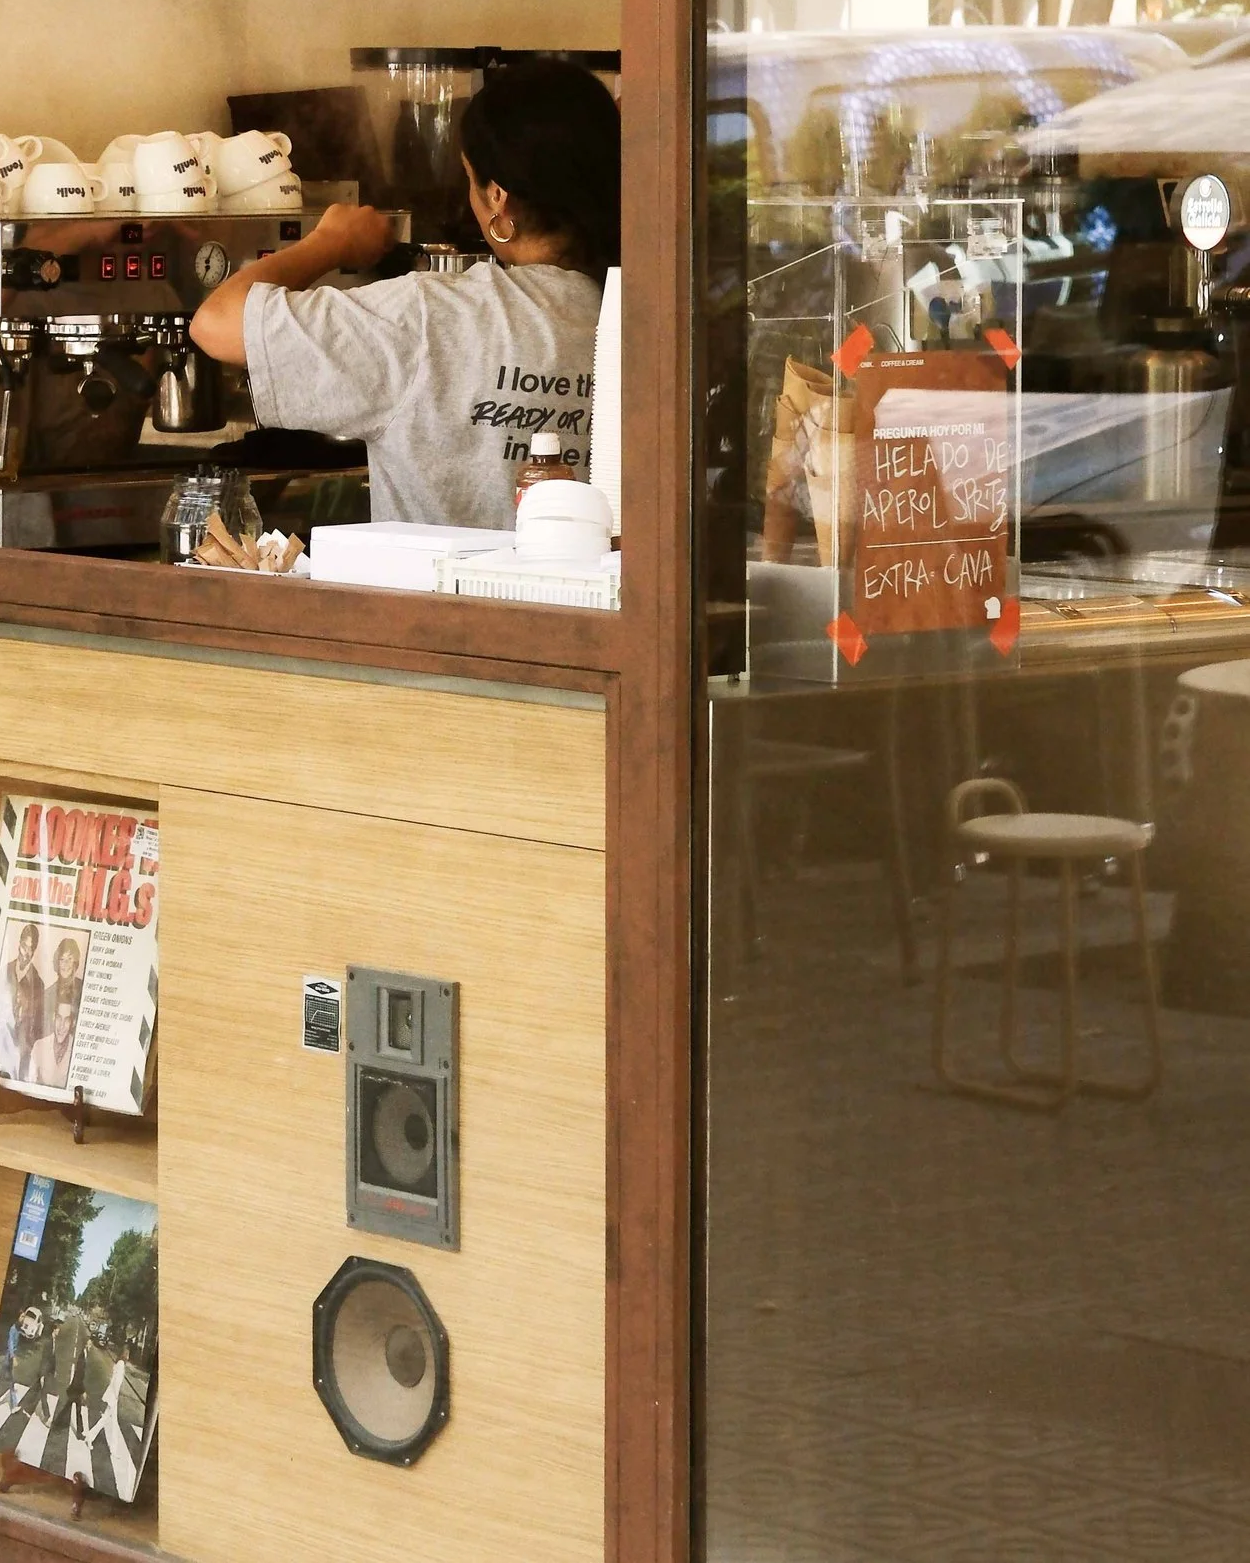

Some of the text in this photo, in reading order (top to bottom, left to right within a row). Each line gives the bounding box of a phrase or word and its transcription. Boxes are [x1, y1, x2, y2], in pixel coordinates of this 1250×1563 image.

[57, 187, 86, 198] fonik
[497, 365, 571, 396] I love
[471, 401, 585, 435] READY OR
[873, 427, 928, 441] PREGUNTA
[930, 424, 950, 437] HOY
[951, 424, 972, 436] POR
[875, 437, 1008, 482] HELADO DE
[863, 486, 948, 532] APEROL
[943, 549, 994, 590] CAVA
